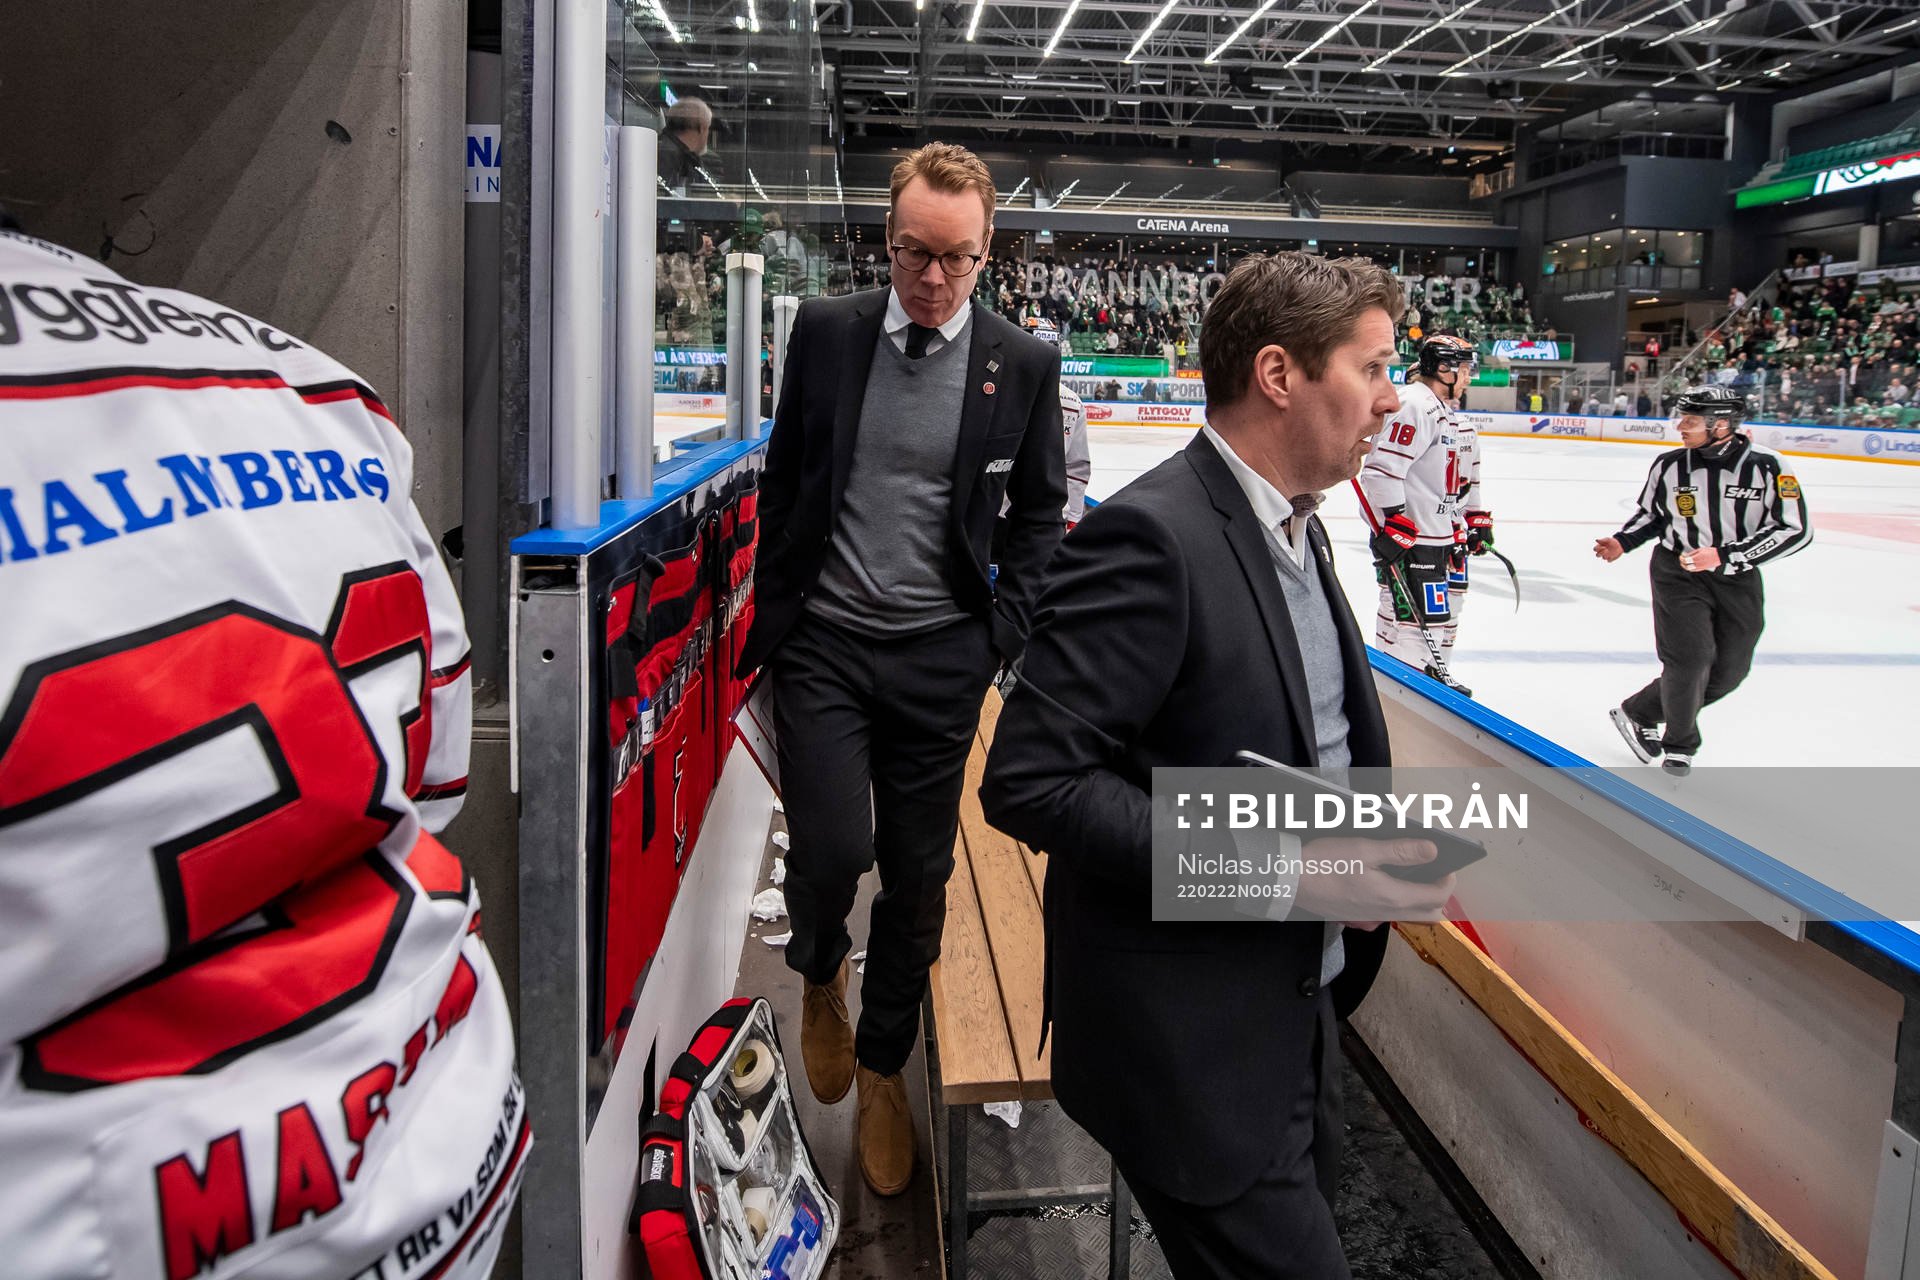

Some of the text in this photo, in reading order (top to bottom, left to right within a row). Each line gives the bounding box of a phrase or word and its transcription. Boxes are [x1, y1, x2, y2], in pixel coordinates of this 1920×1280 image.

[465, 176, 499, 192] IN
[1137, 219, 1229, 233] CATENA Arena
[1025, 261, 1482, 313] BRANNBO TER
[1061, 362, 1092, 374] KTIGT
[1138, 407, 1192, 415] FLYTGOLV
[1552, 417, 1586, 426] INTER
[1389, 422, 1416, 446] 18
[1552, 426, 1586, 435] SPORT
[1726, 487, 1761, 499] SHL
[1746, 540, 1776, 558] CCM
[446, 1188, 474, 1229] VI
[477, 1120, 508, 1198] SOM
